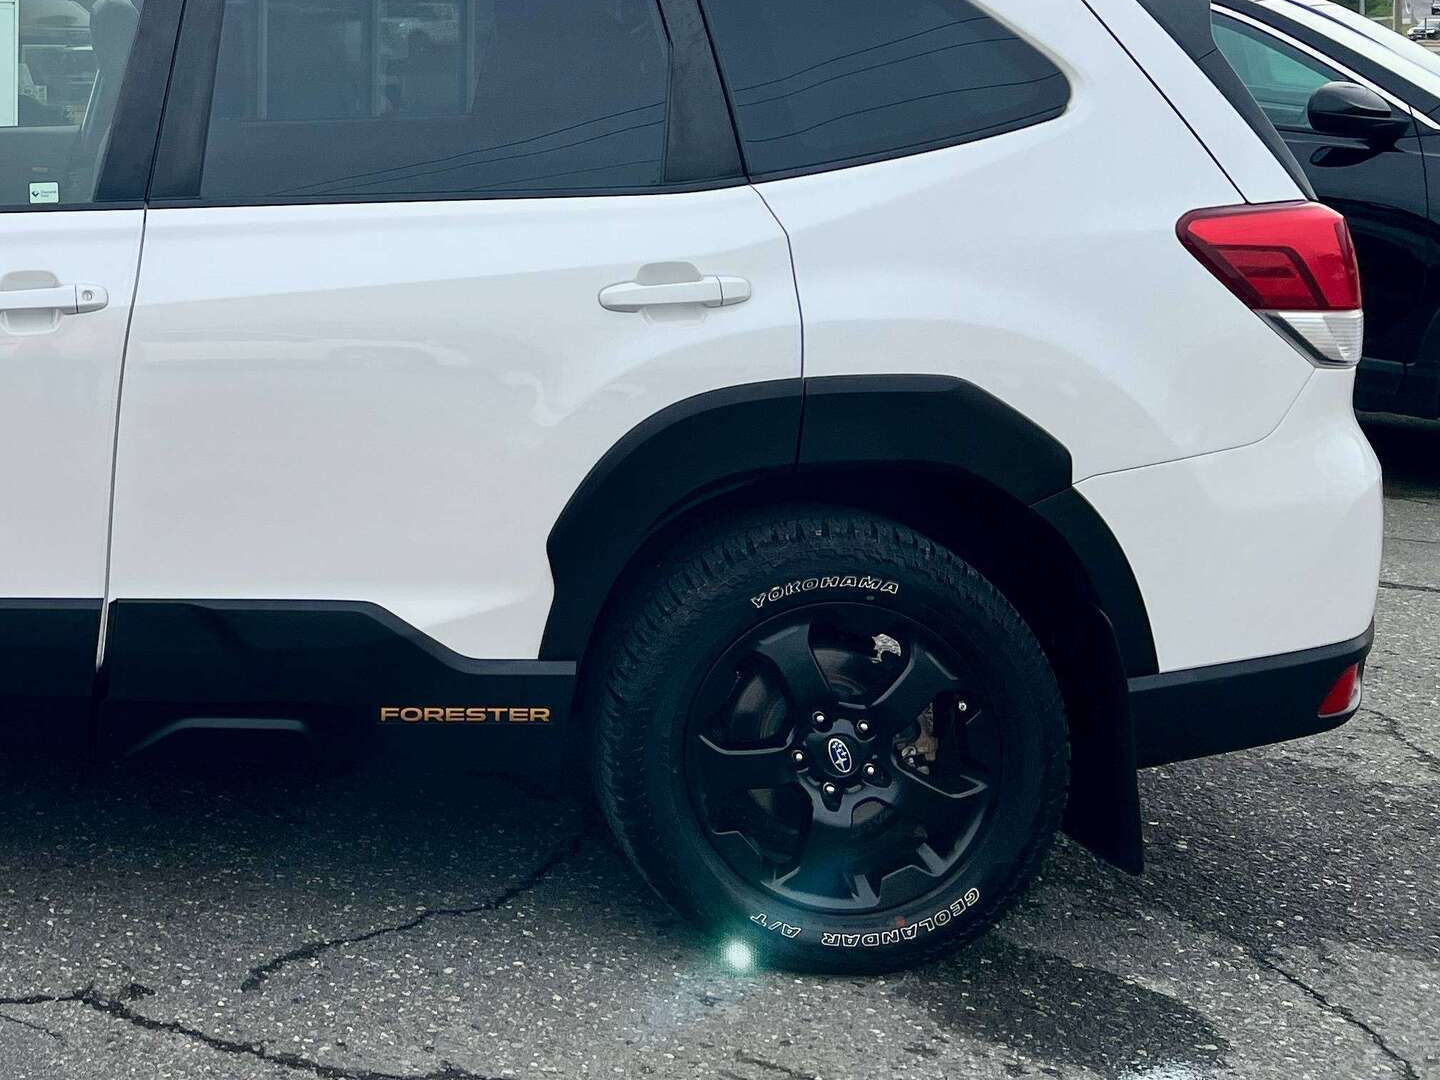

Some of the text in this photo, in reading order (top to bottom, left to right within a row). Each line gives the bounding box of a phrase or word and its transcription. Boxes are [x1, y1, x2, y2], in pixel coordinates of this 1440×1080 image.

[750, 575, 899, 609] YOKOHAMA
[380, 707, 551, 723] FORESTER
[750, 887, 980, 948] GEOLANDAR A/T
